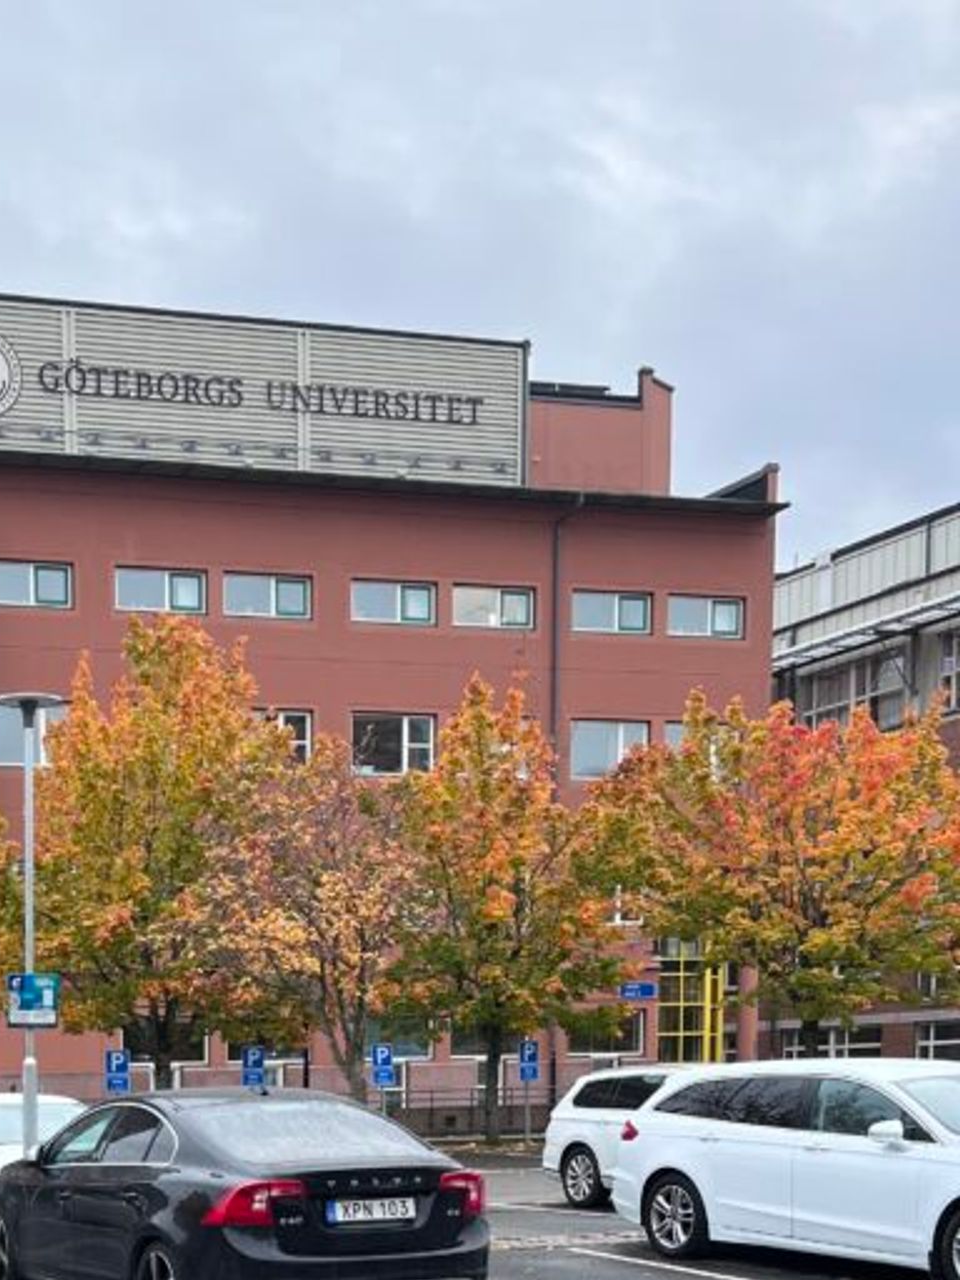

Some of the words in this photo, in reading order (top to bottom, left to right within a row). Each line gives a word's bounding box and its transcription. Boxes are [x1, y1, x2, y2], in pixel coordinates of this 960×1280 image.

[38, 357, 244, 408] GÖTEBORGS
[265, 380, 484, 425] UNIVERSITET
[110, 1052, 125, 1072] P
[247, 1049, 261, 1067] P
[376, 1047, 390, 1065] P
[343, 1202, 374, 1219] XPN
[380, 1200, 409, 1217] 103
